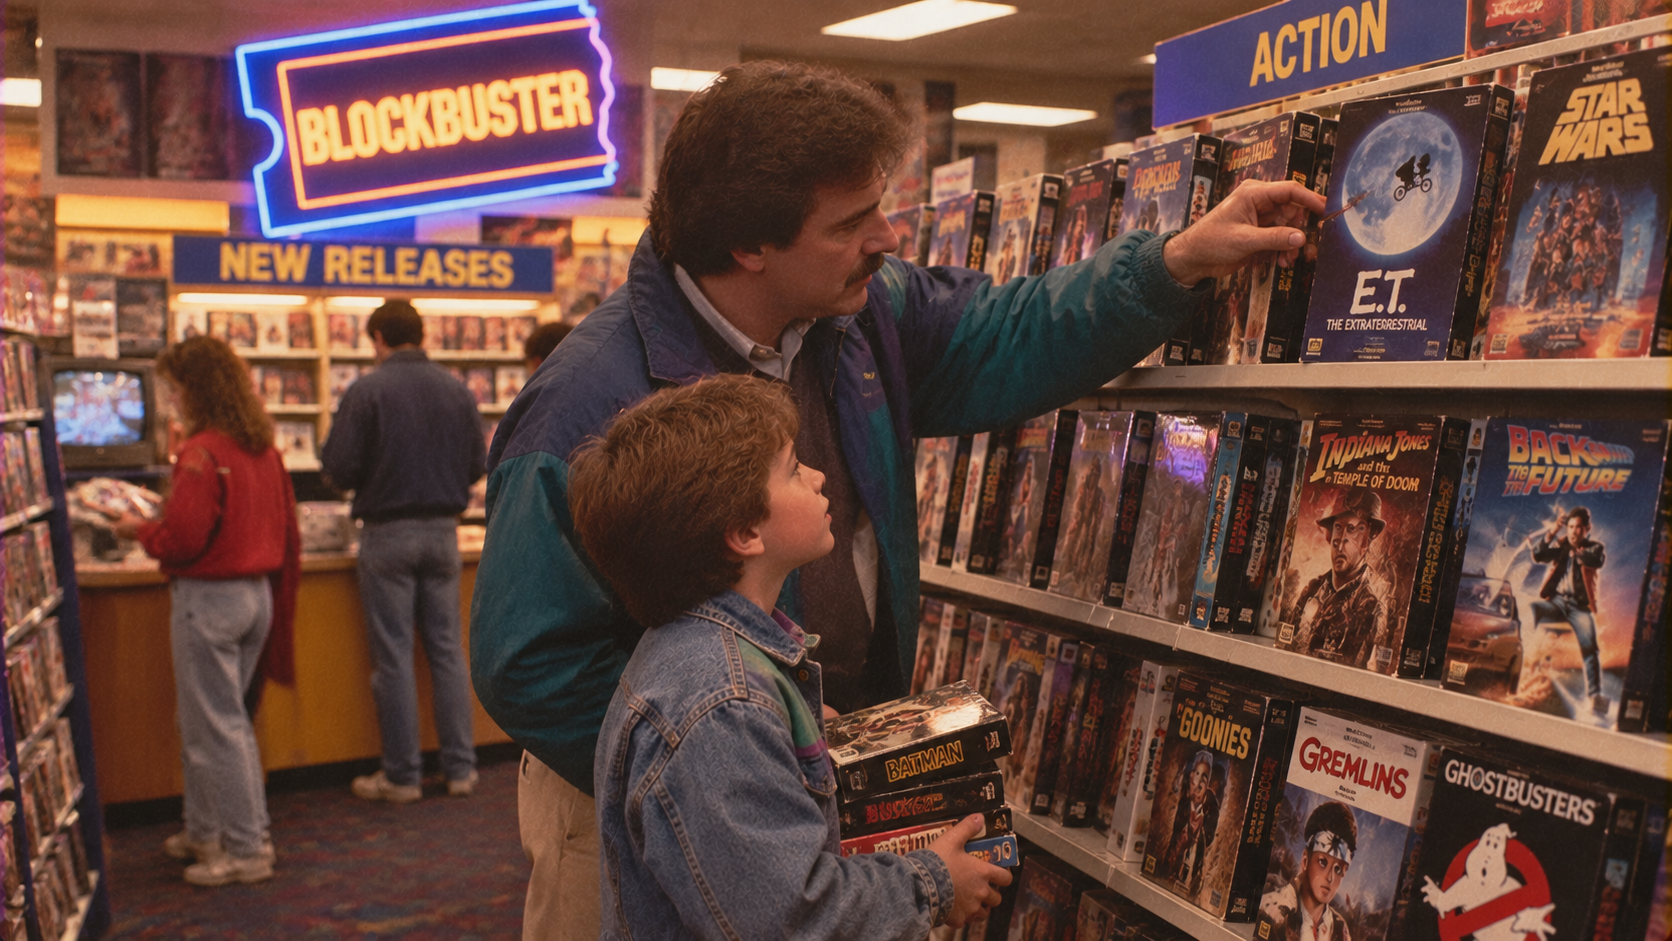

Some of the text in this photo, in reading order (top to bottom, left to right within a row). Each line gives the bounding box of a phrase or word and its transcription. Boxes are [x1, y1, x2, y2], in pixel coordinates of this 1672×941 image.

[1249, 0, 1388, 87] ACTION
[297, 69, 593, 167] BLOCKBUSTER
[1556, 78, 1647, 126] STAR
[1538, 112, 1655, 166] WARS
[220, 242, 515, 288] NEW RELEASES
[1350, 268, 1416, 315] E.T.
[1326, 318, 1343, 331] THE
[1386, 430, 1433, 462] JONES
[1507, 424, 1600, 467] BACK
[1333, 471, 1370, 488] TEMPLE
[1370, 474, 1386, 489] OF
[1522, 465, 1633, 496] FUTURE
[1179, 706, 1252, 760] GOONIES
[885, 740, 964, 783] BATMAN
[1299, 736, 1410, 800] GREMLINS
[1444, 759, 1596, 827] GHOSTBUSTERS
